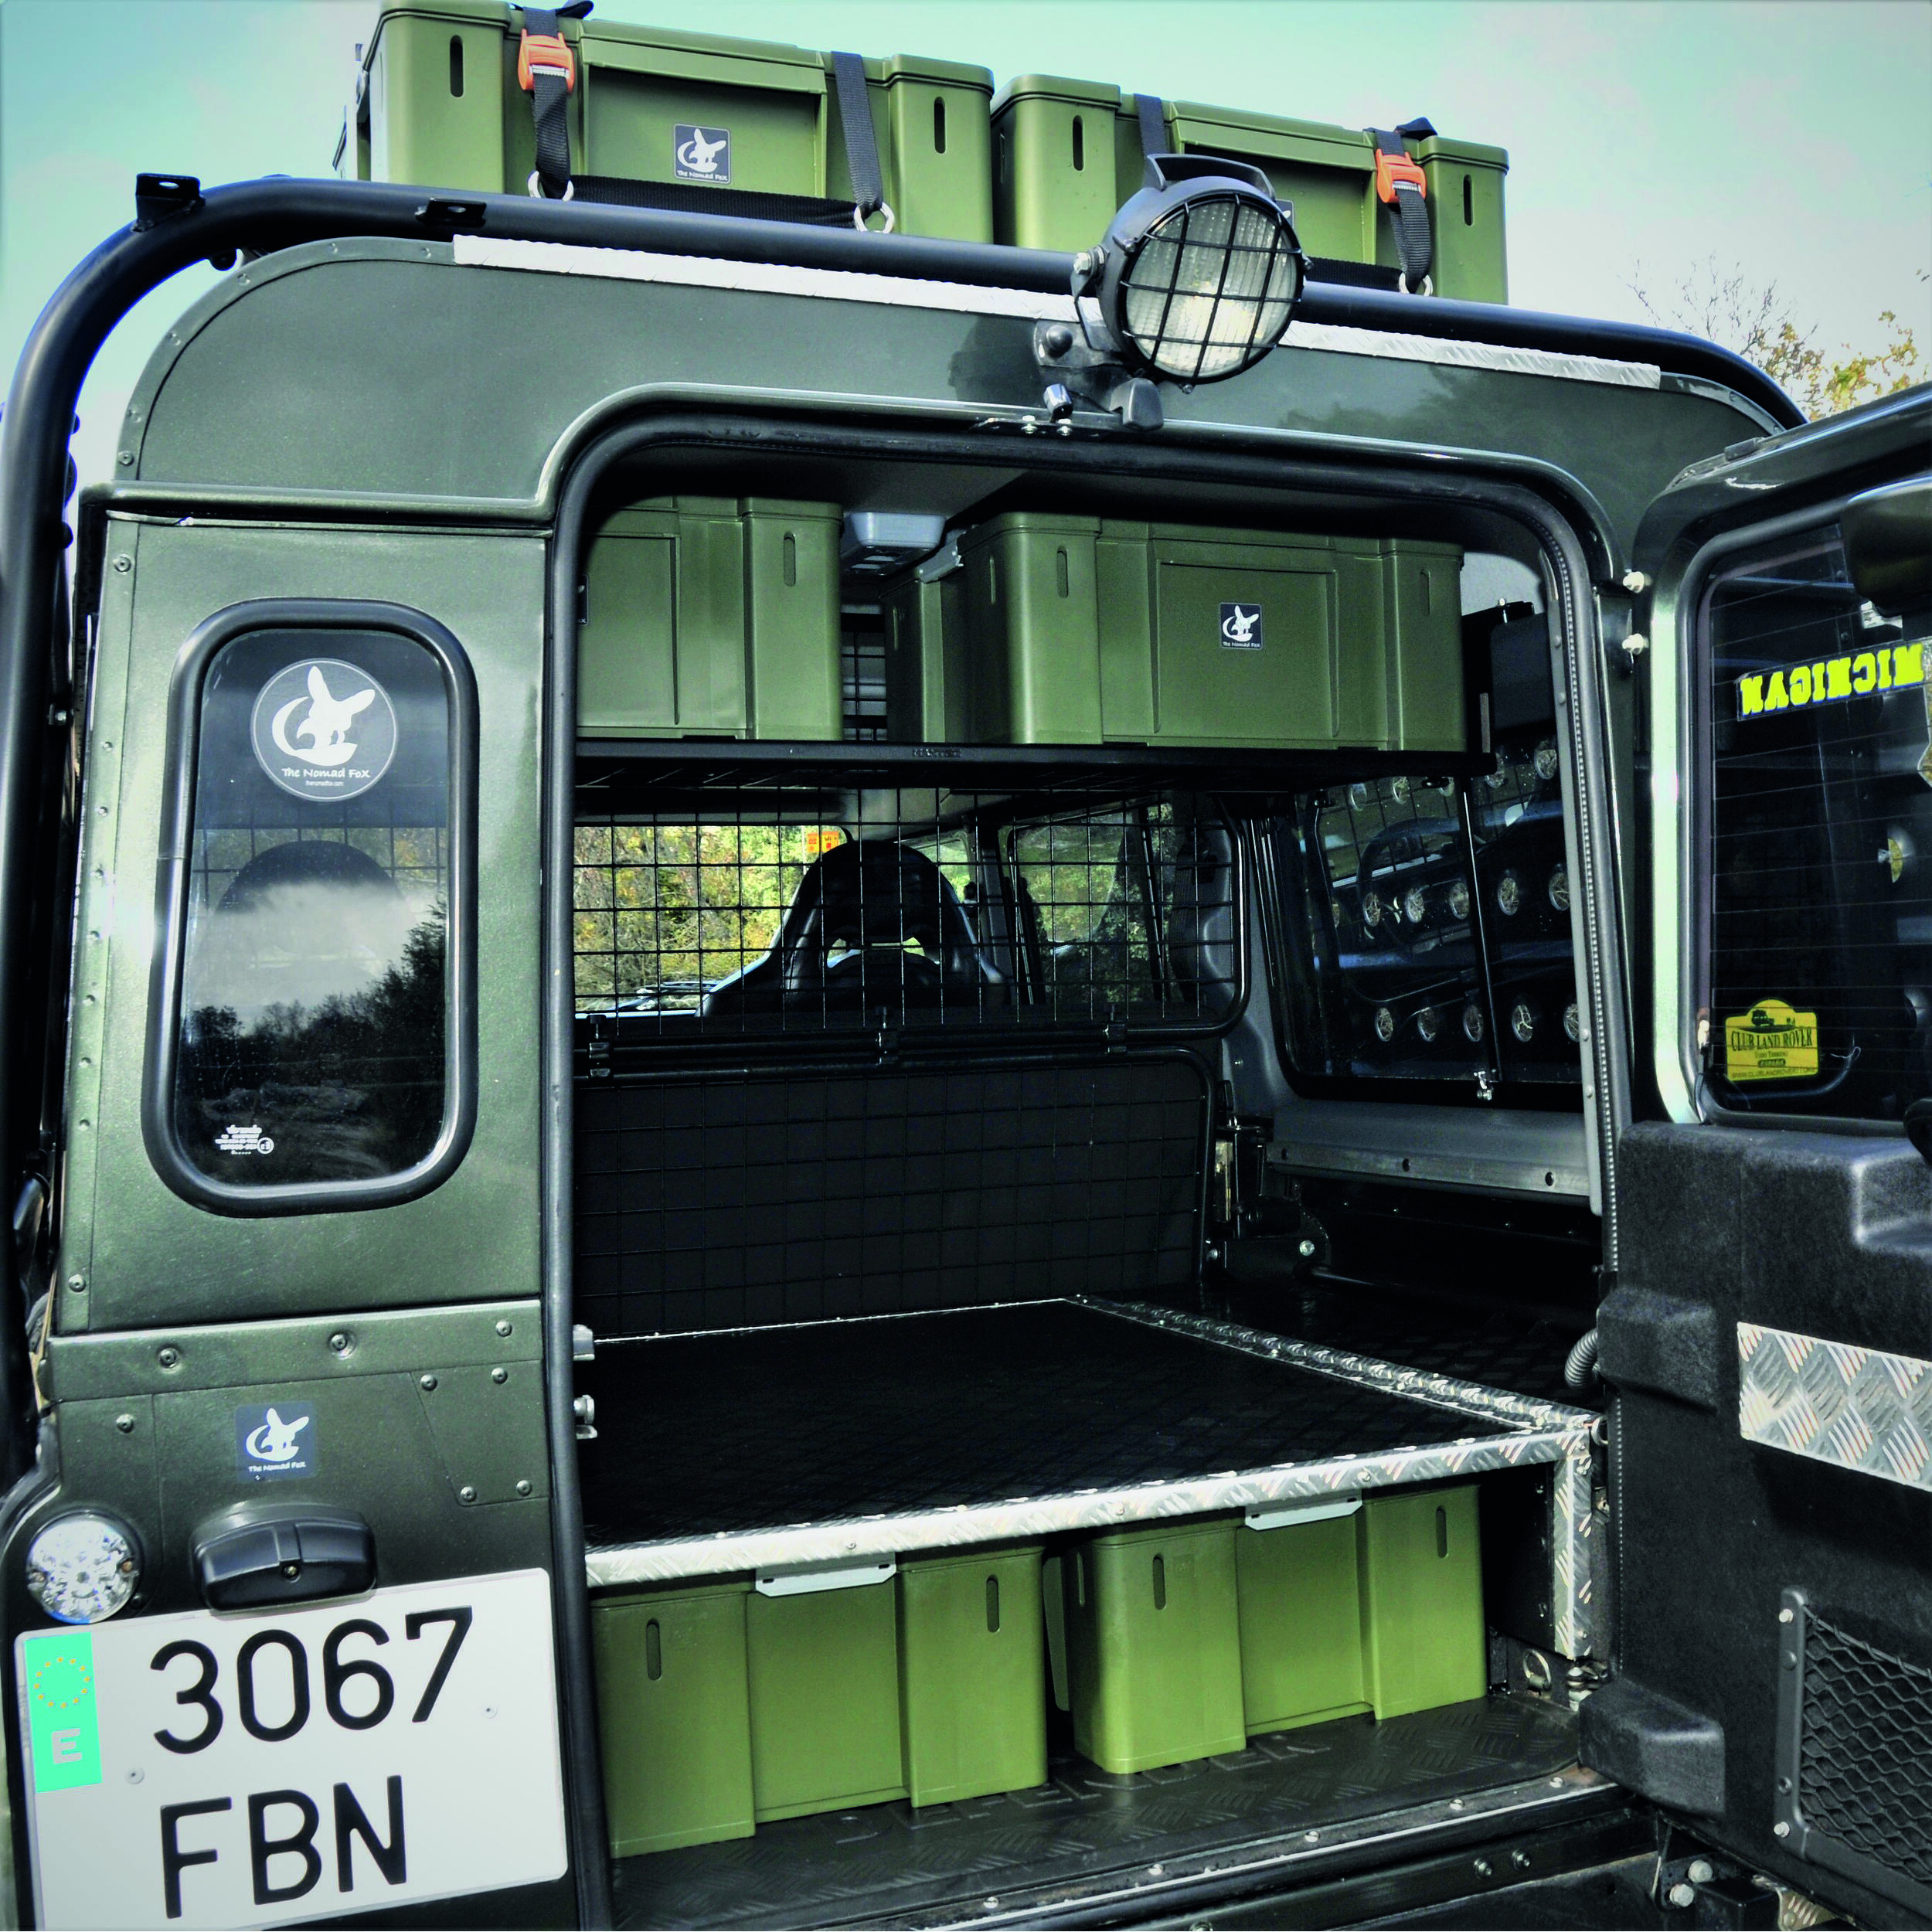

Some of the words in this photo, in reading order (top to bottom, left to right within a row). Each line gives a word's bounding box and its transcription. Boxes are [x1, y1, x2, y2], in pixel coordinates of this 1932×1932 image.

[281, 767, 301, 777] The
[303, 767, 345, 777] Nomad
[1731, 1030, 1754, 1051] CLUB
[1757, 1034, 1781, 1049] LAND
[1783, 1026, 1813, 1047] ROVER
[150, 1605, 473, 1754] 3067
[51, 1728, 82, 1764] E
[160, 1775, 407, 1919] FBN
